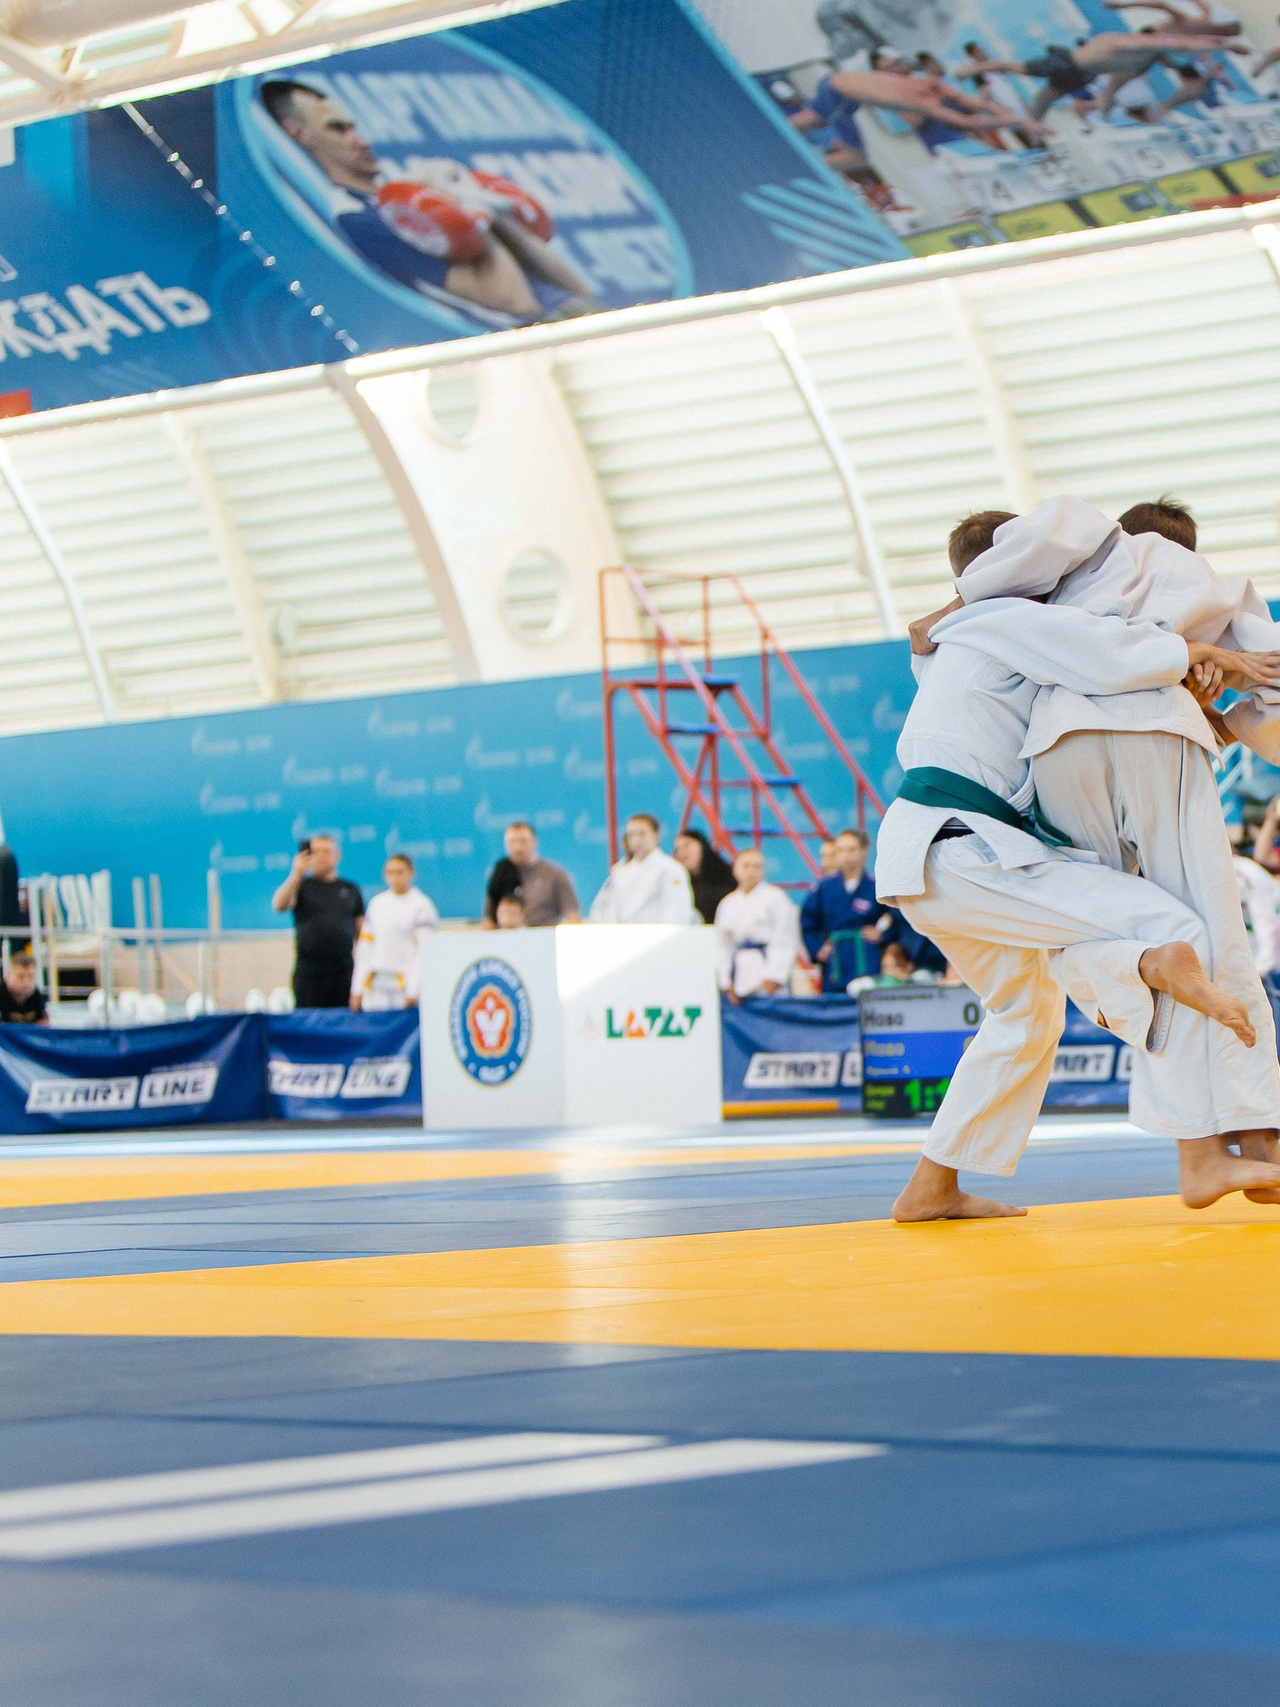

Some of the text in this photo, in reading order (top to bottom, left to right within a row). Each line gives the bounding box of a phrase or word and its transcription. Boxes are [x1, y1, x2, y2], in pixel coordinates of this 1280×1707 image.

[962, 1002, 980, 1027] 0
[755, 1060, 833, 1080] START
[1053, 1053, 1106, 1073] ART
[35, 1077, 206, 1107] START LINE
